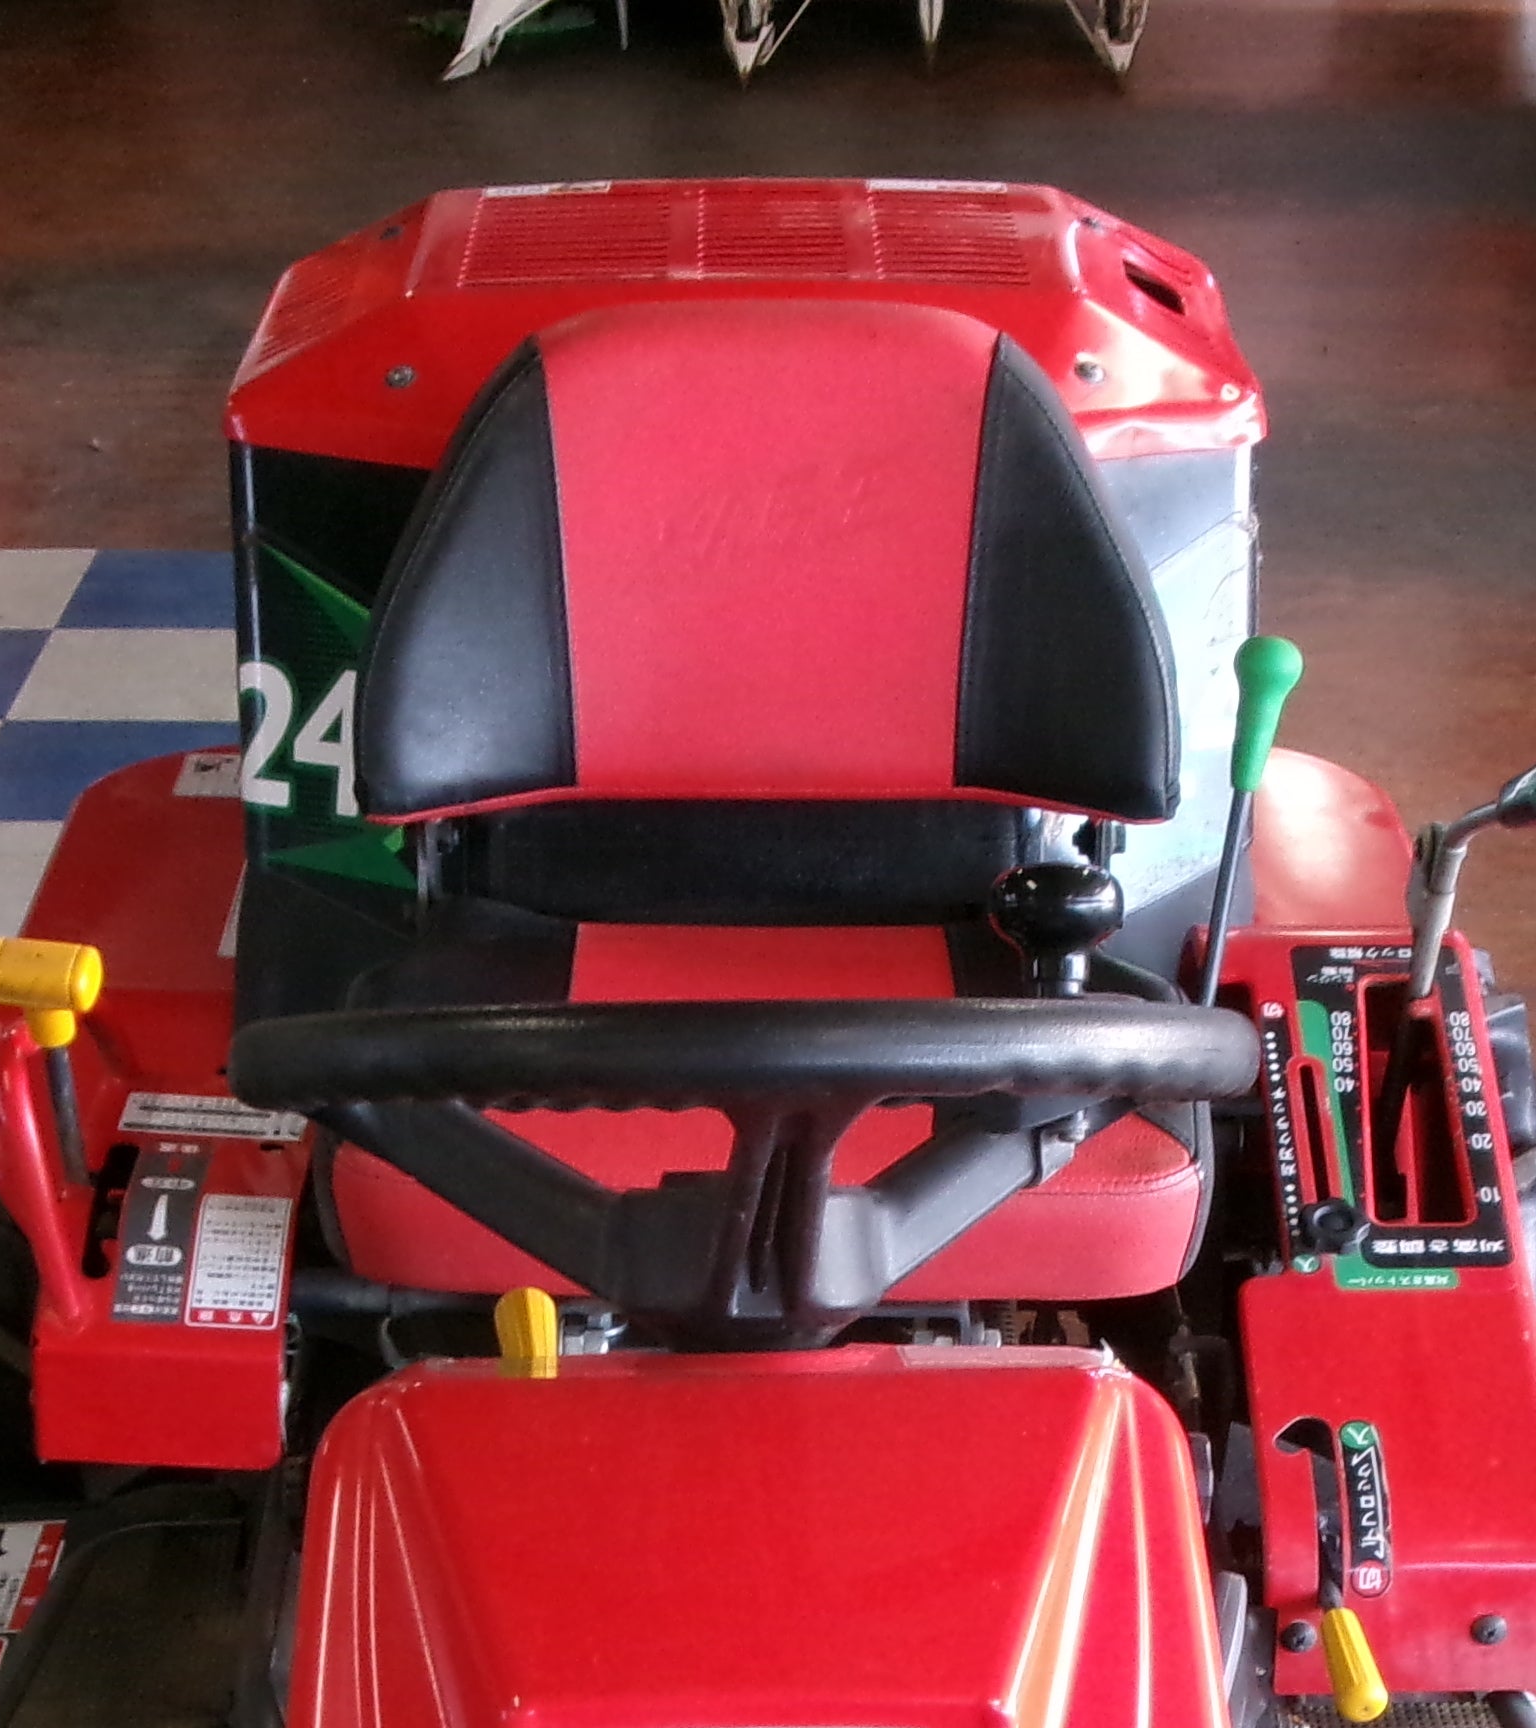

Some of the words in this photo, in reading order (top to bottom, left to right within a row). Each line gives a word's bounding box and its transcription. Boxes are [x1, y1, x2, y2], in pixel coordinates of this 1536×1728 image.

[240, 661, 359, 815] 24
[1330, 1010, 1352, 1026] 80
[1450, 1010, 1470, 1026] 80
[1332, 1026, 1352, 1041] 70
[1452, 1026, 1472, 1041] 70
[1332, 1041, 1353, 1056] 60
[1455, 1041, 1476, 1055] 60
[1333, 1056, 1354, 1072] 50
[1459, 1056, 1479, 1072] 50
[1334, 1077, 1355, 1092] 40
[1461, 1076, 1482, 1092] 40
[1465, 1101, 1487, 1116] 30
[1471, 1133, 1493, 1149] 20
[1480, 1185, 1501, 1203] 10
[1371, 1238, 1505, 1254] 刈高さ調整
[1346, 1427, 1370, 1446] 入
[1358, 1463, 1379, 1548] デフロック
[1358, 1568, 1382, 1591] 切
